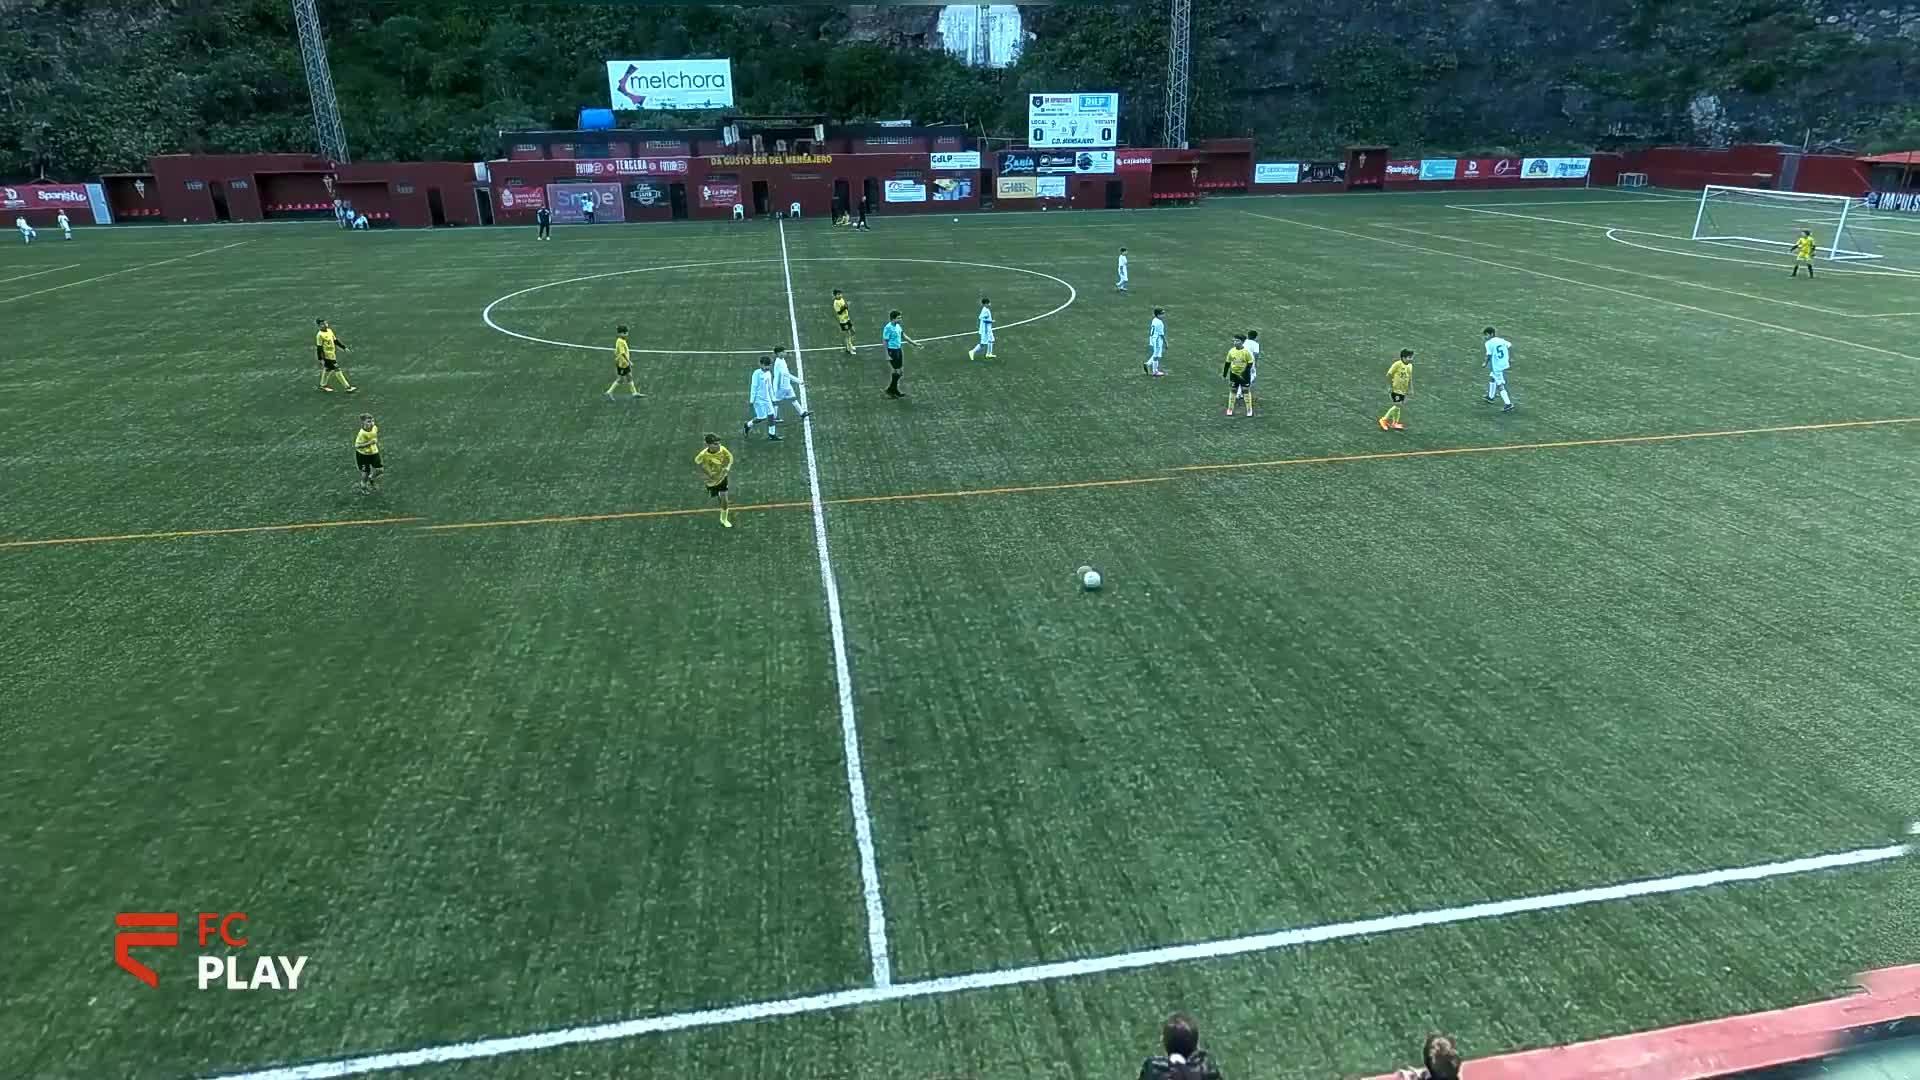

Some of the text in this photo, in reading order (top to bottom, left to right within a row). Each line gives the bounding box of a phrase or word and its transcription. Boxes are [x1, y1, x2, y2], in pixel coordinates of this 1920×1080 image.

[630, 71, 725, 89] melchora
[1033, 128, 1044, 141] 0
[1101, 128, 1112, 141] 0
[615, 159, 648, 171] TERCERA
[723, 156, 751, 166] GUSTO
[751, 156, 768, 165] SER
[769, 156, 784, 165] DEL
[785, 154, 833, 165] MENSAJERO
[1496, 344, 1505, 360] 5
